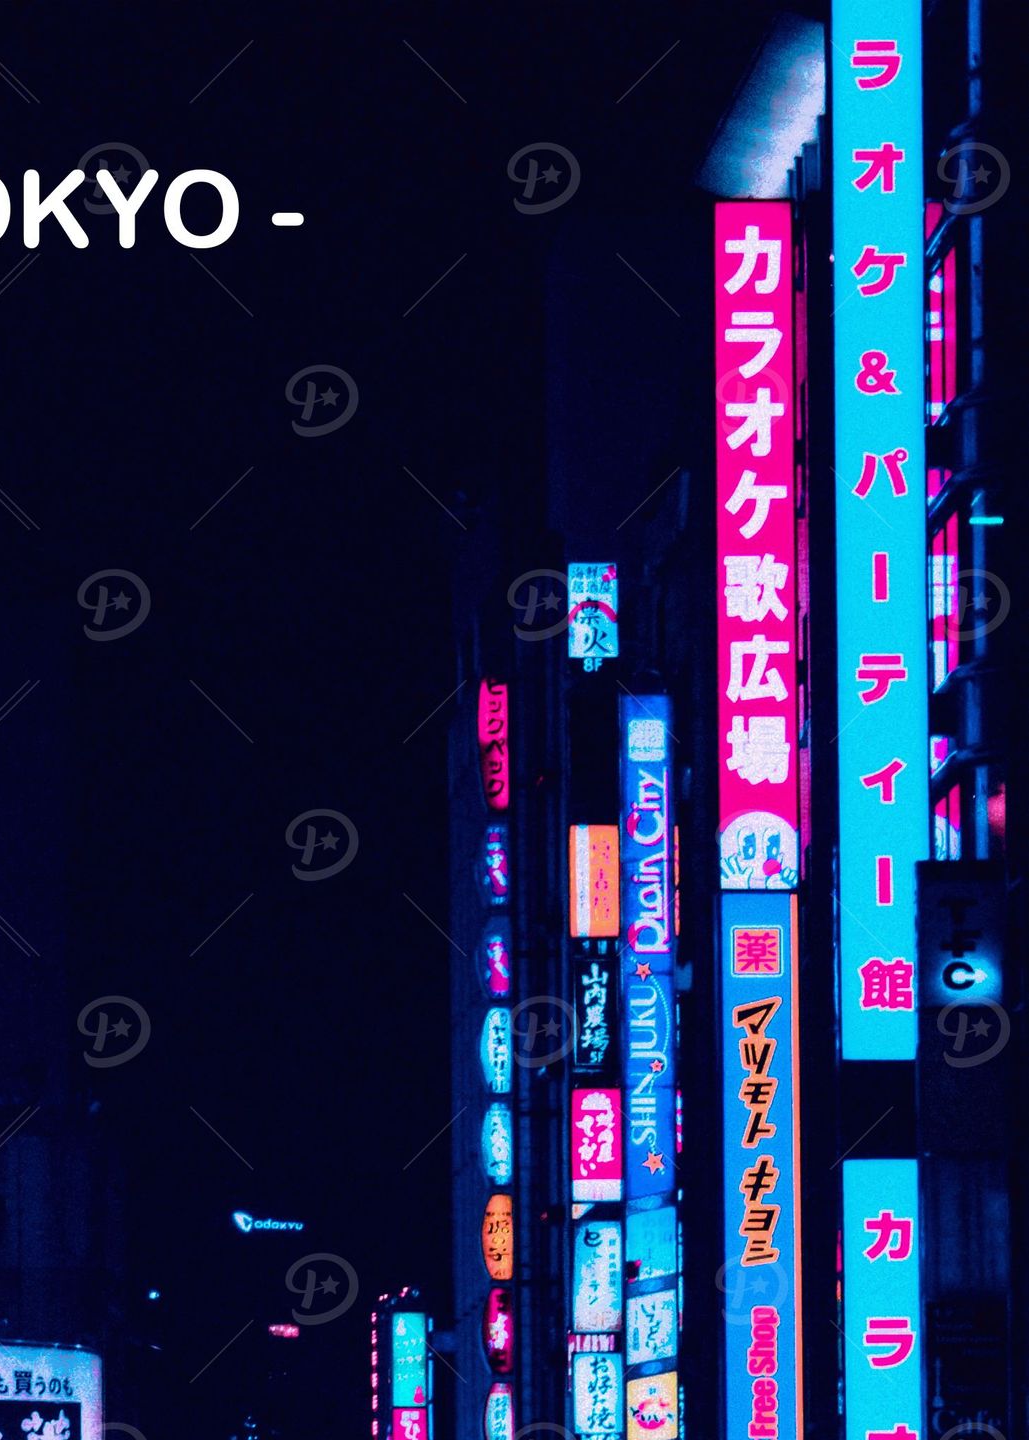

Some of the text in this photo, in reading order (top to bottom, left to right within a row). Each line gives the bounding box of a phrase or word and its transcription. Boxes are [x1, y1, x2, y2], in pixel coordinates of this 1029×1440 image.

[724, 225, 790, 785] カラオケ歌広場
[737, 931, 778, 971] 薬
[735, 997, 781, 1264] マツモトキヨシ
